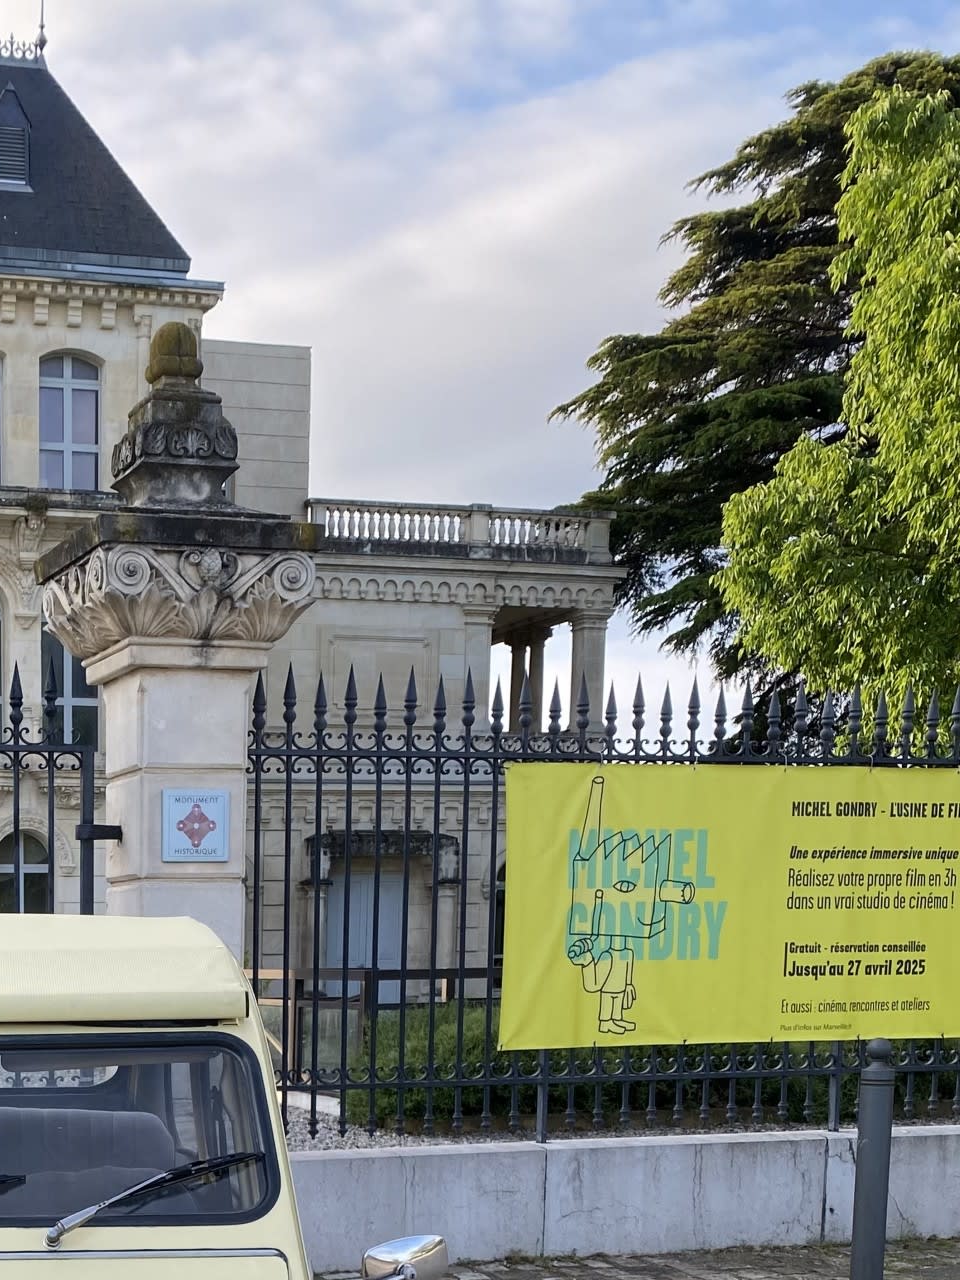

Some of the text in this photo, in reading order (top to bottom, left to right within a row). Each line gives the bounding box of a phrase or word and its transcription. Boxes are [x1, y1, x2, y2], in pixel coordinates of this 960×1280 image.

[791, 801, 832, 817] MICHEL
[836, 801, 877, 817] GONDRY
[890, 802, 928, 818] L'USINE
[931, 803, 945, 818] DE
[567, 828, 716, 889] MICHEL
[790, 846, 959, 863] Une expérience immersive unique
[788, 868, 957, 892] Réalisez votre propre film en 3h
[787, 891, 814, 910] dans
[817, 896, 831, 909] un
[834, 891, 855, 909] vrai
[857, 891, 890, 909] studio
[893, 891, 906, 909] de
[909, 891, 948, 909] cinéma
[565, 900, 728, 961] GONDRY
[789, 942, 821, 953] Gratuit
[830, 941, 879, 953] réservation
[882, 941, 926, 953] conseillée
[788, 959, 926, 980] Jusqu'au 27 avril 2025
[781, 999, 789, 1014] Et
[791, 1000, 812, 1013] aussi
[850, 1001, 890, 1012] rencontres
[891, 1000, 899, 1011] et
[901, 997, 930, 1011] ateliers
